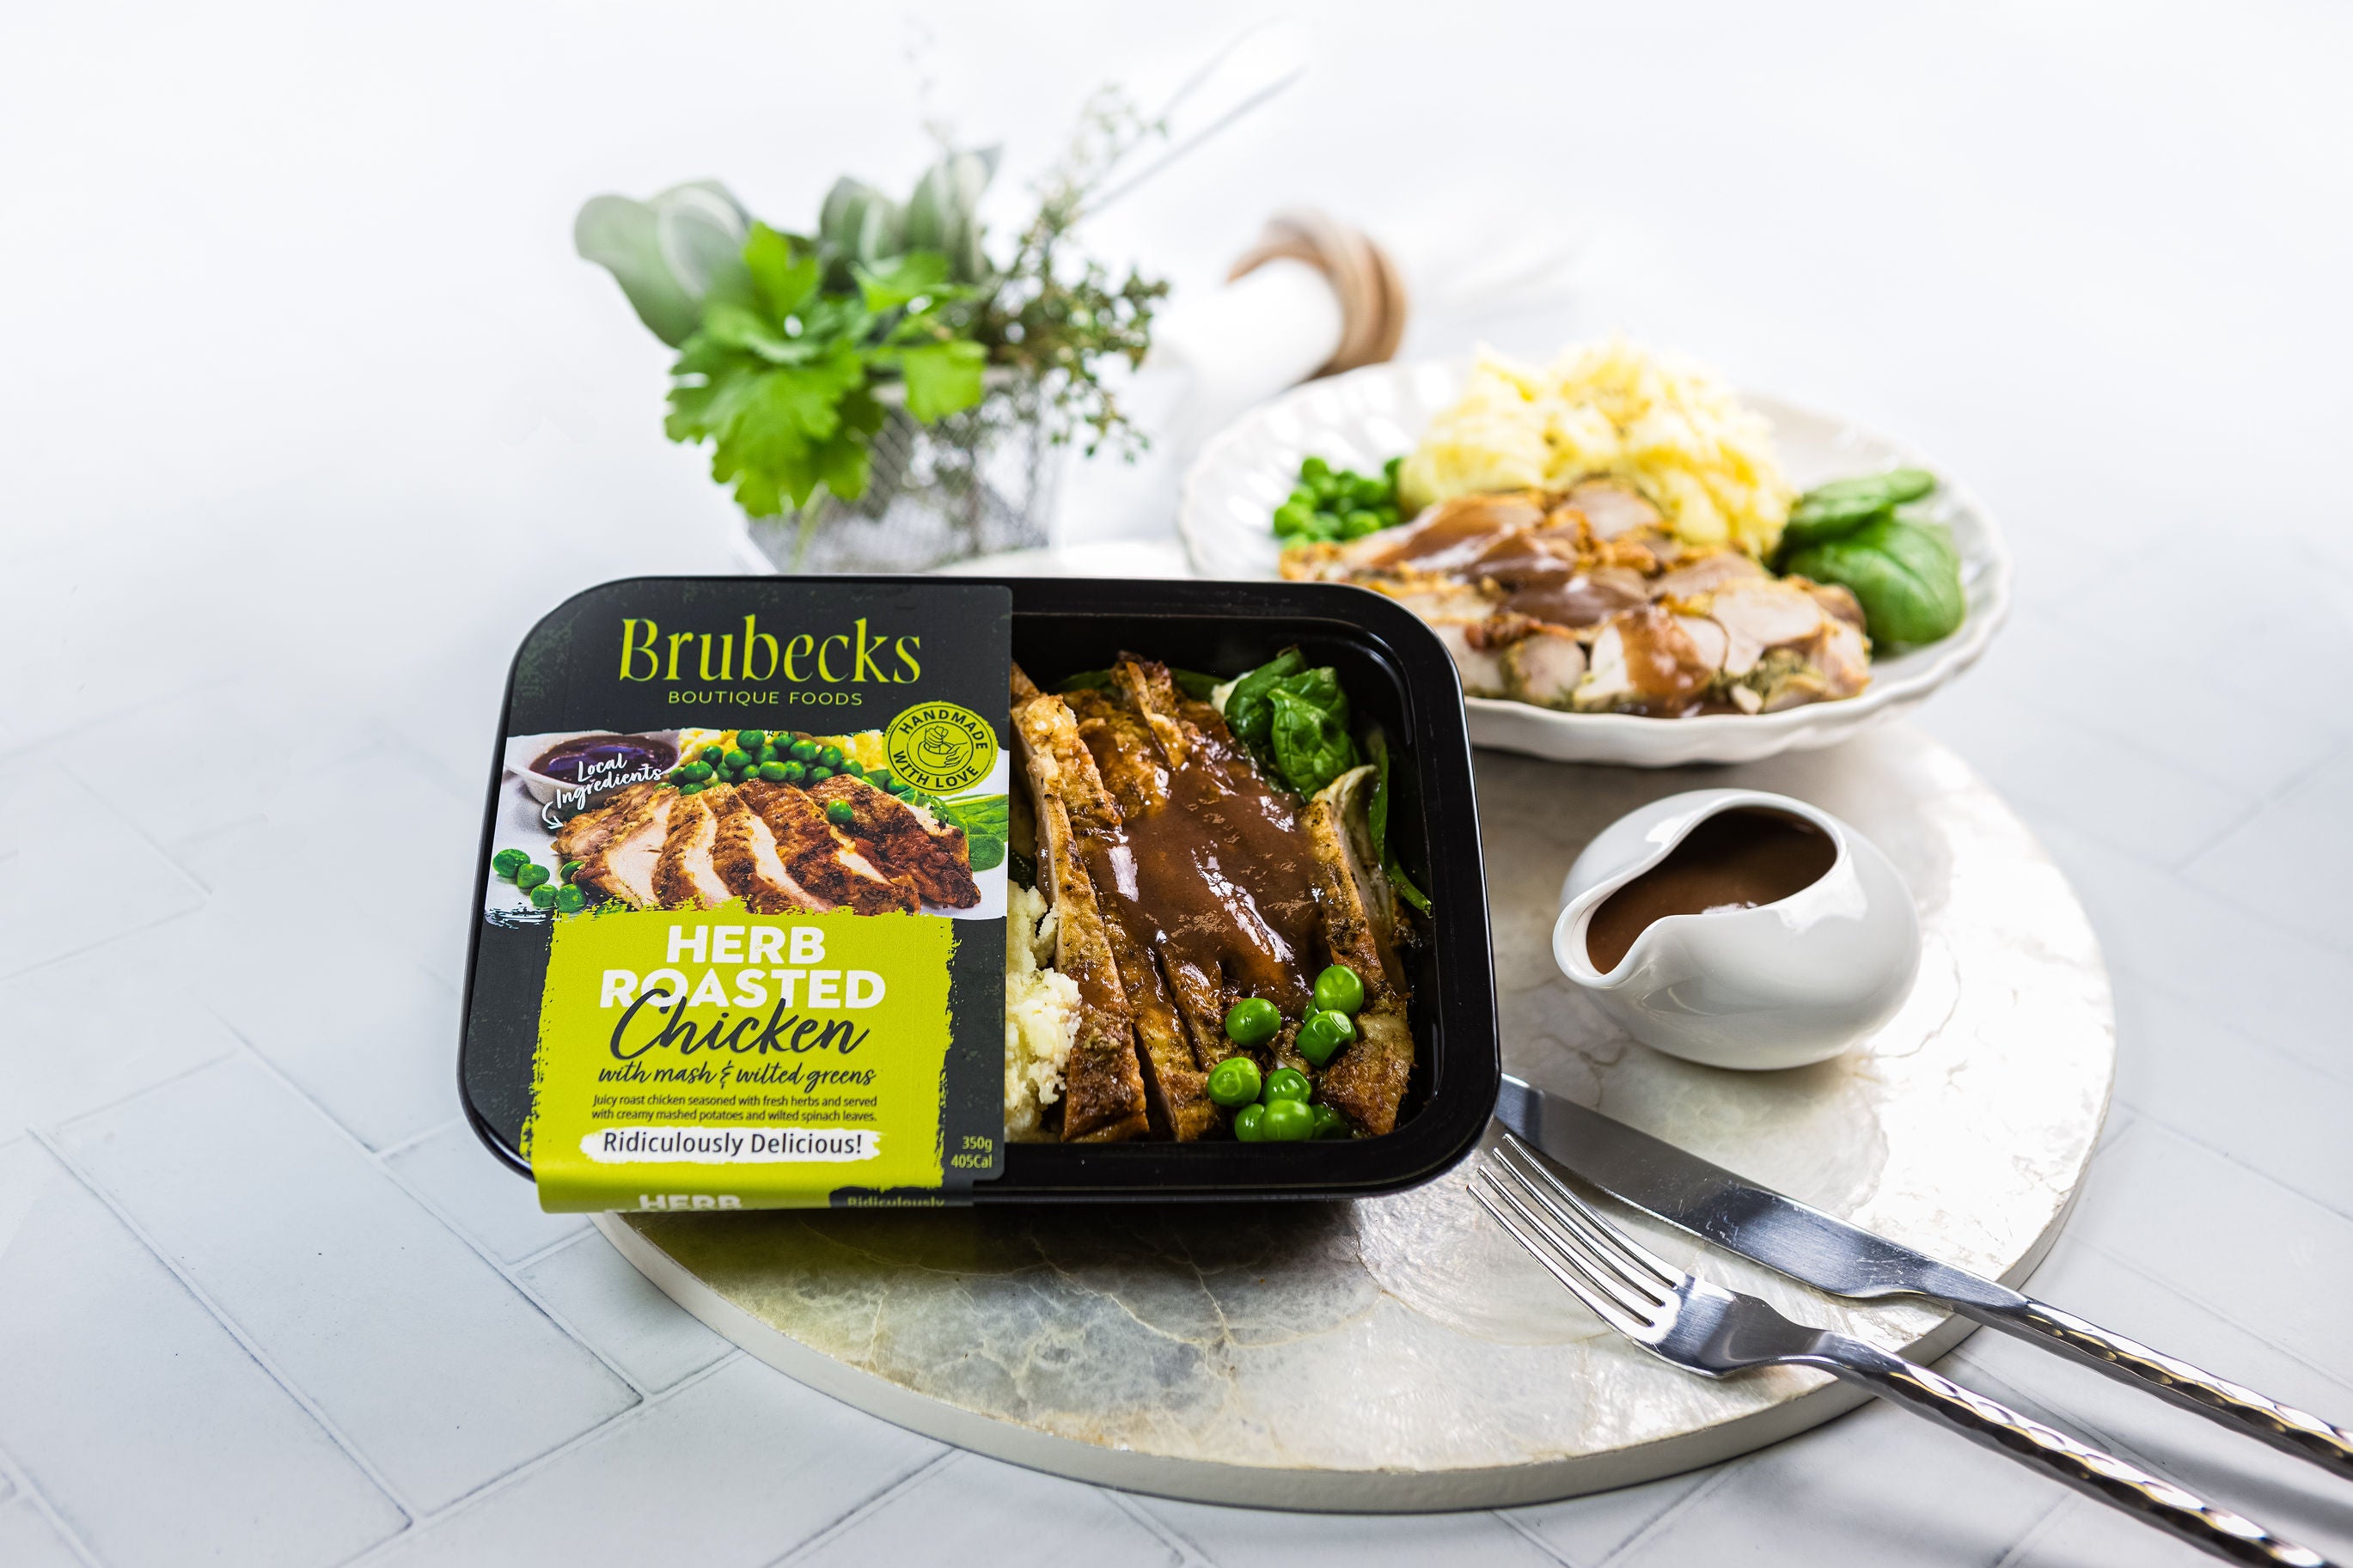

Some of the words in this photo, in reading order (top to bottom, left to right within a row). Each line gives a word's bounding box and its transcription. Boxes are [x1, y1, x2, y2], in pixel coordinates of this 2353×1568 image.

[619, 613, 920, 684] Brubecks
[668, 691, 779, 706] BOUTIQUE
[789, 692, 863, 706] FOODS
[899, 709, 988, 749] HANDMADE
[578, 753, 627, 783] Local
[893, 750, 930, 785] WITH
[935, 766, 979, 788] LOVE
[555, 763, 662, 810] Ingredients
[666, 925, 826, 964] HERB
[599, 968, 886, 1010] ROASTED
[610, 988, 871, 1060] Chicken
[598, 1060, 651, 1083] with
[653, 1061, 717, 1084] mash
[719, 1060, 735, 1089] &
[736, 1062, 804, 1085] wilted
[804, 1069, 877, 1094] greens
[591, 1109, 614, 1120] with
[616, 1111, 654, 1123] creamy
[656, 1109, 697, 1120] mashed
[699, 1111, 743, 1123] potatoes
[746, 1110, 767, 1121] and
[768, 1110, 799, 1121] wilted
[801, 1110, 839, 1123] spinach
[842, 1110, 877, 1121] leaves.
[592, 1095, 618, 1107] Juicy
[619, 1095, 645, 1106] roast
[647, 1095, 686, 1106] chicken
[688, 1095, 736, 1106] seasoned
[738, 1095, 761, 1107] with
[762, 1095, 788, 1107] fresh
[791, 1095, 819, 1107] herbs
[822, 1095, 841, 1107] and
[843, 1095, 877, 1107] served
[603, 1132, 743, 1156] Ridiculously
[751, 1132, 862, 1154] Delicious!
[950, 1154, 993, 1168] 405Cal
[962, 1135, 993, 1153] 350g
